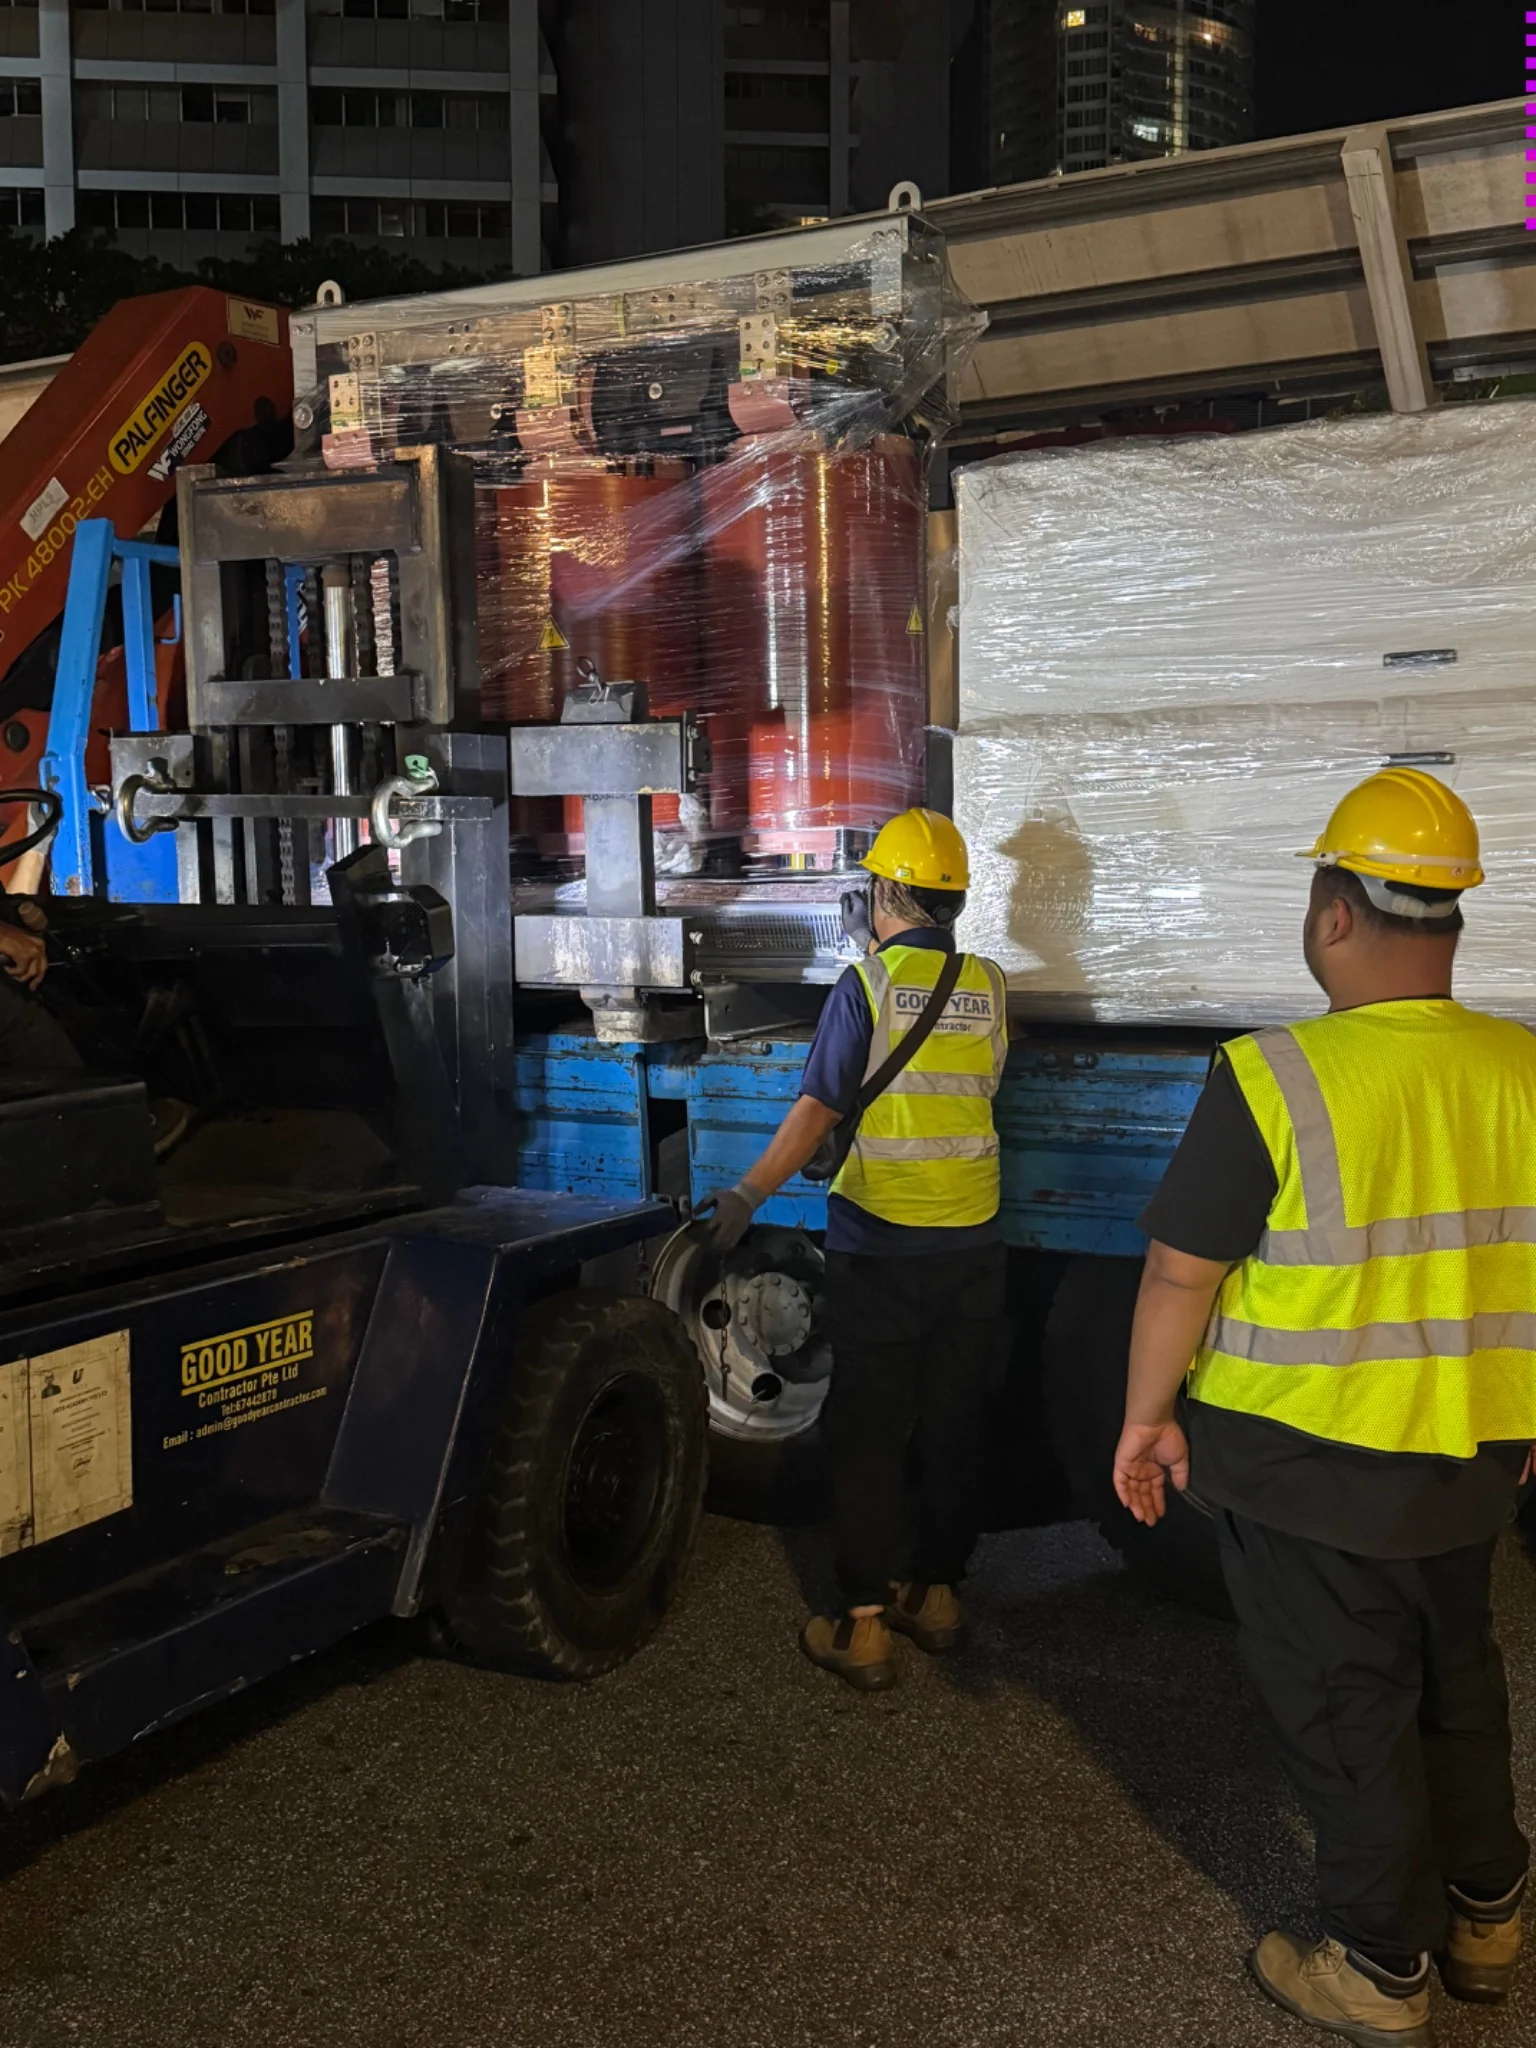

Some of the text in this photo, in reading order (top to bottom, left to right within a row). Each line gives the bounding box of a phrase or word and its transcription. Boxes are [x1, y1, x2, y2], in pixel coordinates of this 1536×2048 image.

[112, 349, 209, 467] PALFINGER
[169, 409, 208, 457] WONGFONG
[0, 465, 116, 613] PK 48002-EH
[934, 1021, 972, 1032] ntractor
[950, 997, 991, 1015] YEAR
[181, 1319, 313, 1387] GOOD YEAR
[198, 1363, 299, 1408] Contractor Pte Ltd
[162, 1430, 189, 1450] Email
